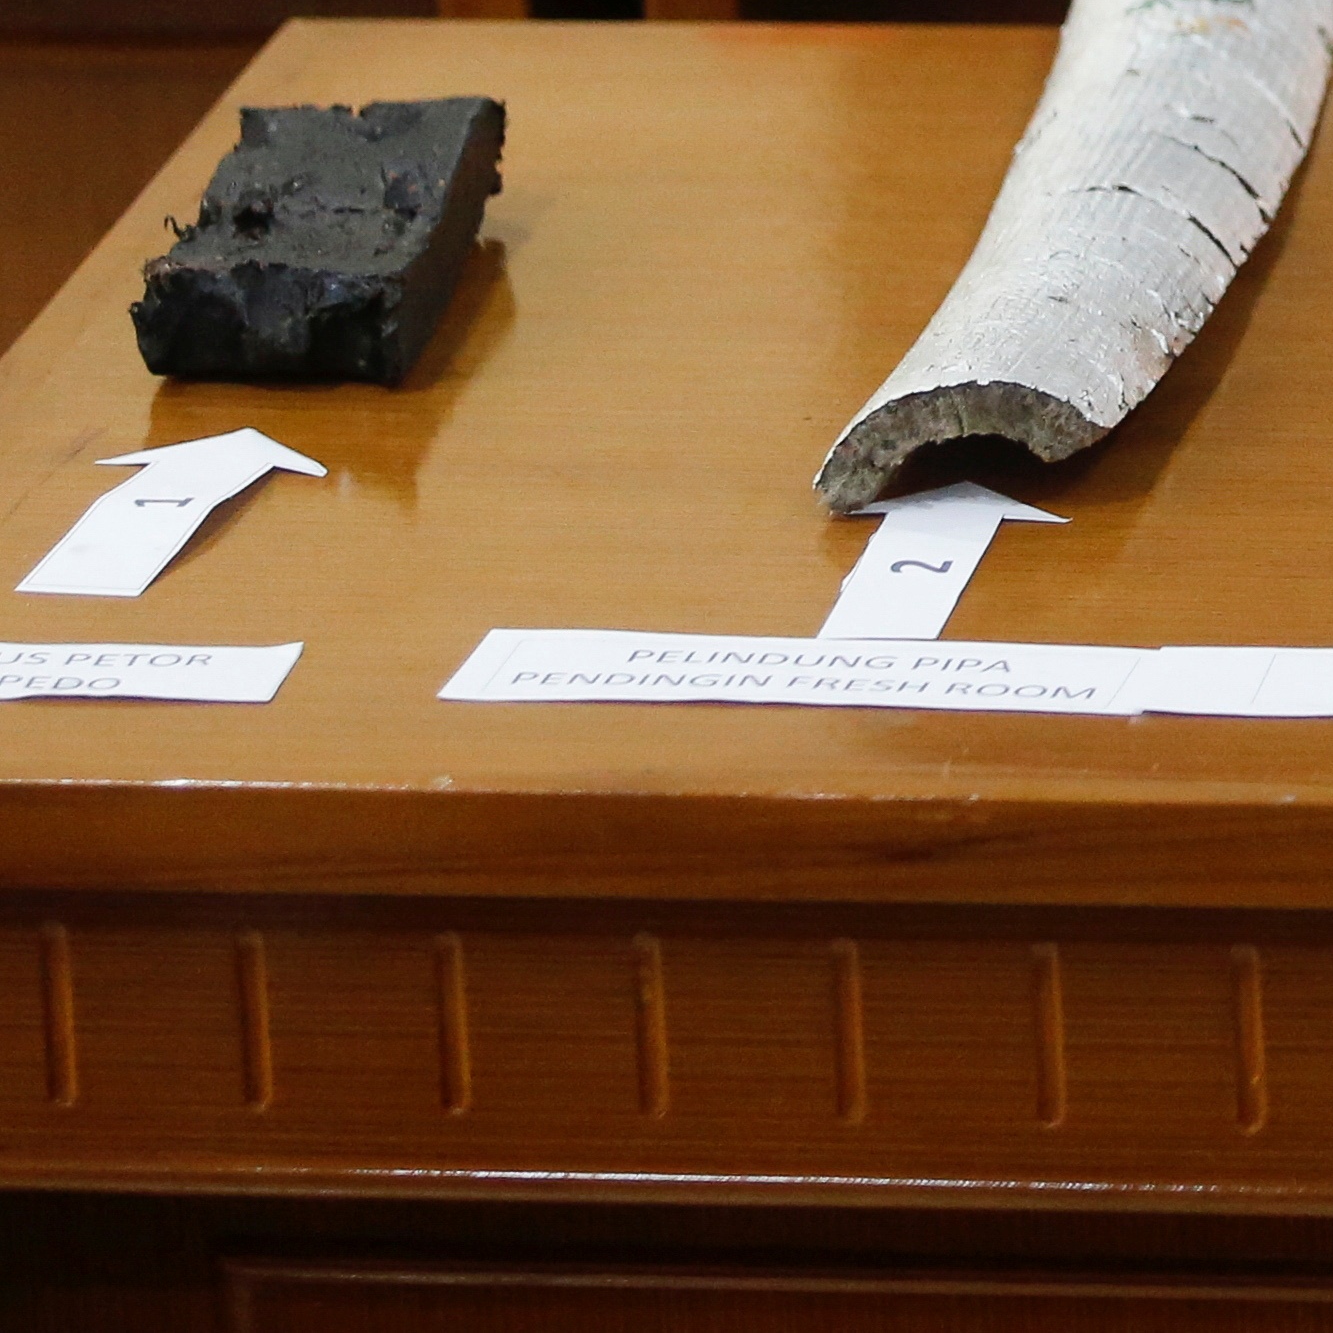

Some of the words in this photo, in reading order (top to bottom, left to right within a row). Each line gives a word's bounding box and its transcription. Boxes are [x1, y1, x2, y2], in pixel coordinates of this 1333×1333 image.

[134, 496, 195, 507] 1
[890, 559, 954, 573] 2
[63, 652, 213, 668] PETOR
[626, 649, 898, 670] PELINDUNG
[910, 655, 1011, 674] PIPA
[0, 673, 122, 691] PEDO
[510, 671, 773, 688] PENDINGIN
[785, 675, 930, 694] FRESH
[944, 681, 1097, 700] ROOM
